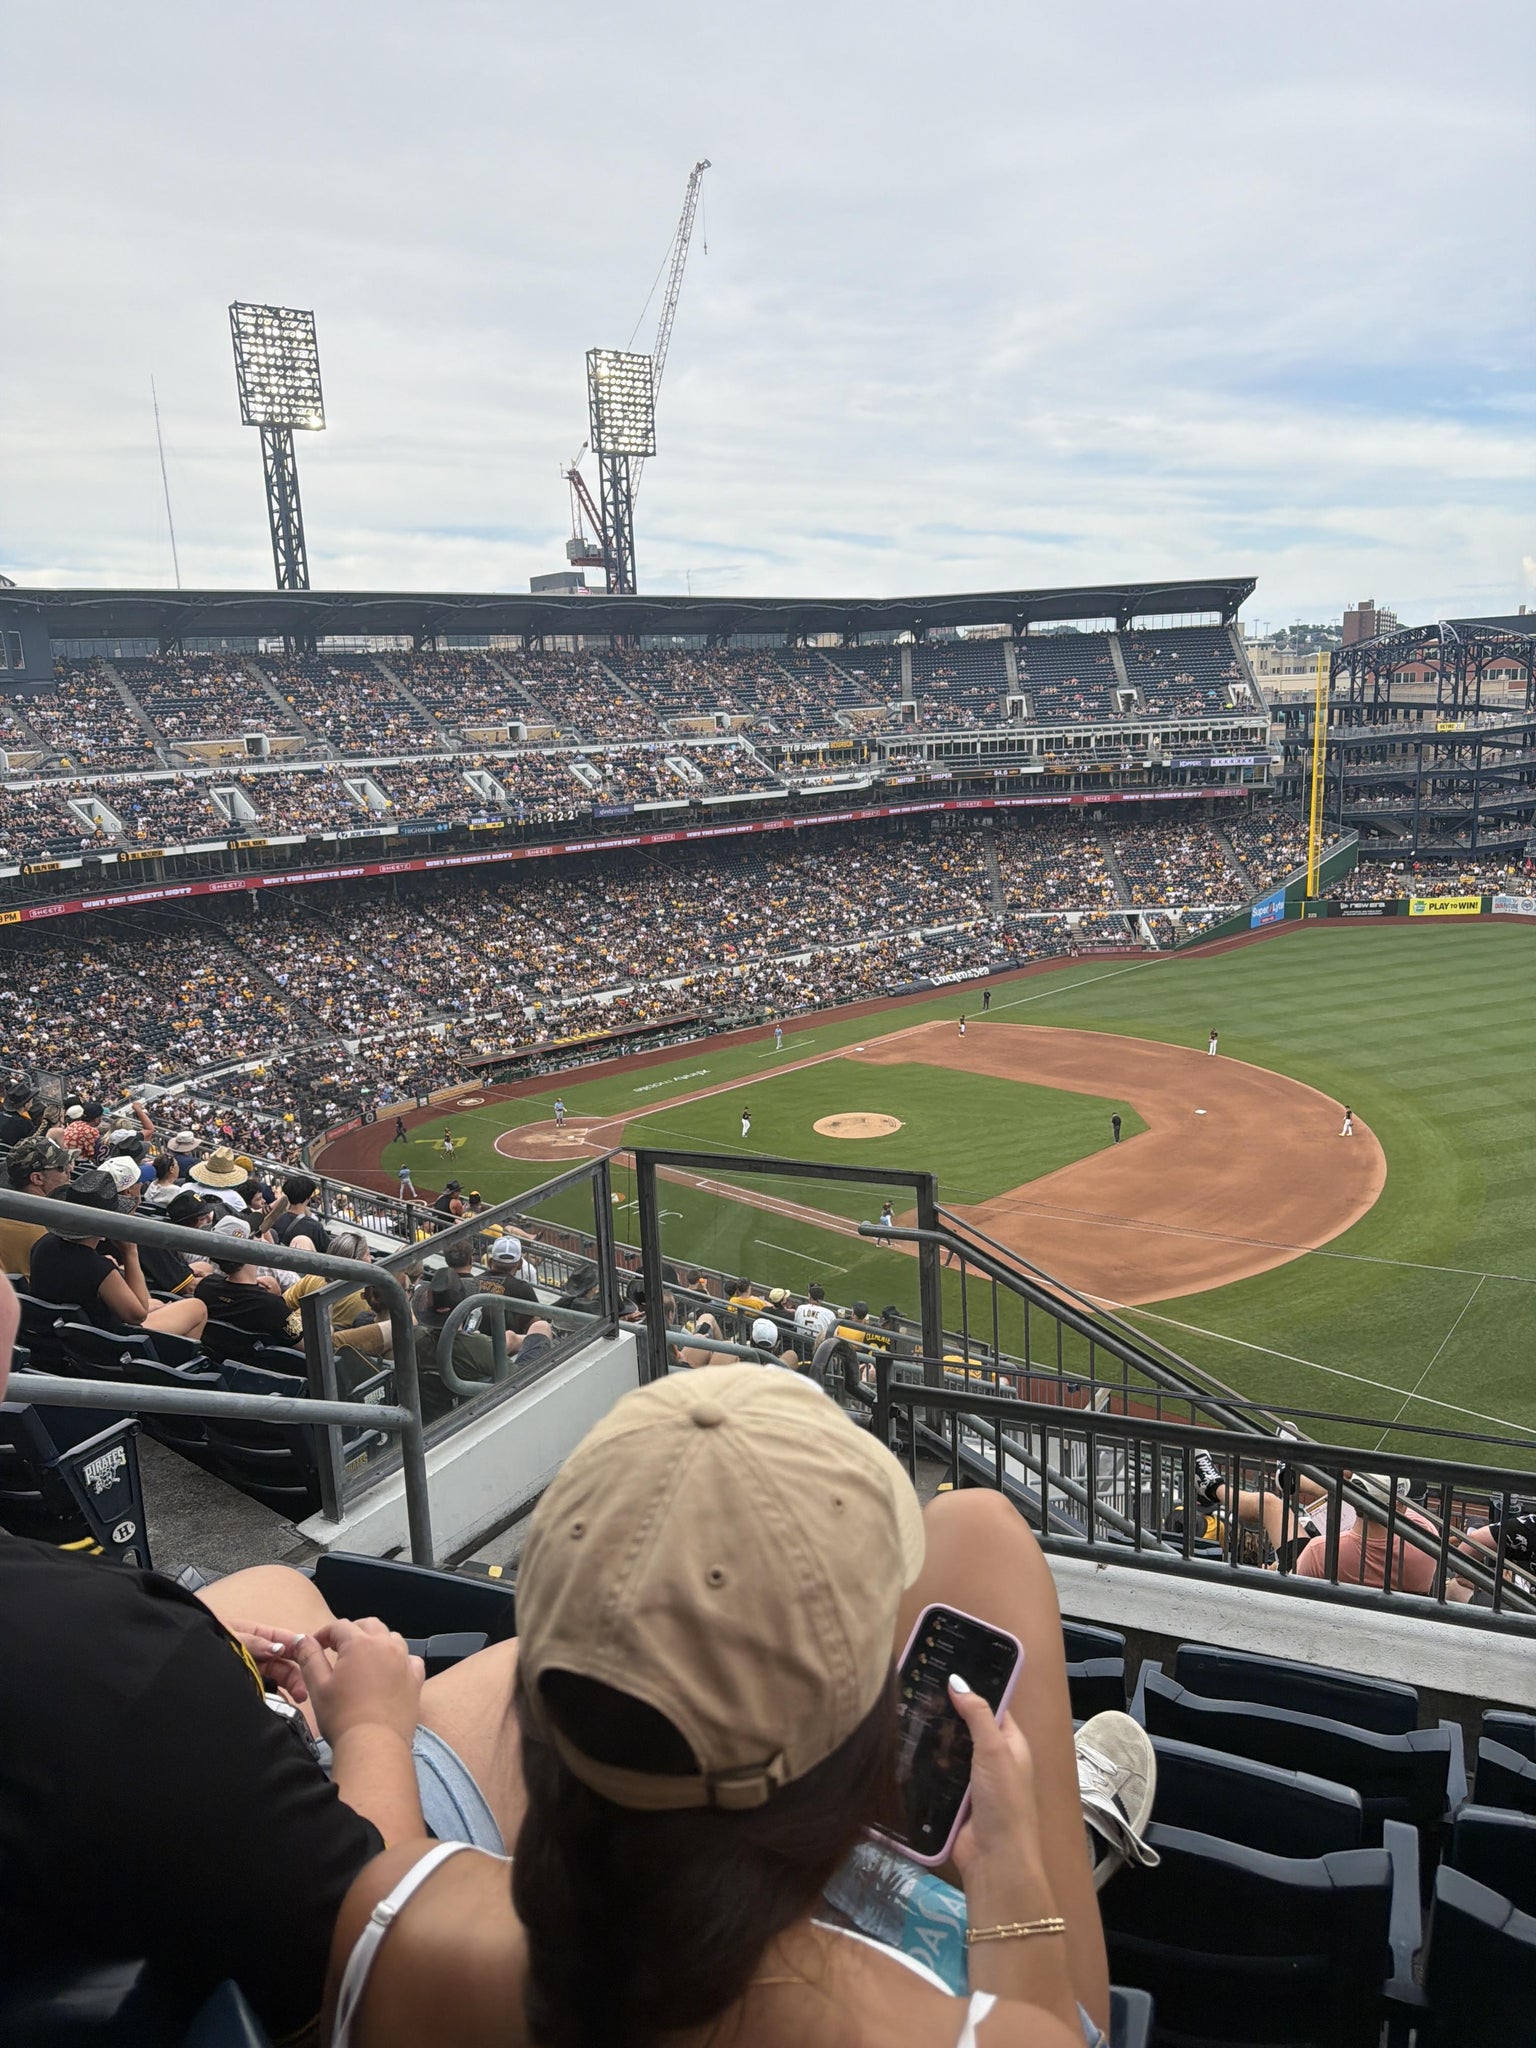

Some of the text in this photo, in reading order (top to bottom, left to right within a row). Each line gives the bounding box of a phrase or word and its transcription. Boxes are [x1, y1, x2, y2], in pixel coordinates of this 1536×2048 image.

[781, 745, 794, 753] CITY
[794, 744, 801, 752] OF
[801, 742, 830, 751] CHAMPIONS
[547, 812, 554, 822] 2
[557, 811, 564, 821] 2
[567, 810, 575, 821] 2
[337, 831, 348, 840] 42
[406, 826, 436, 835] HIGHMARK
[229, 840, 237, 849] 11
[119, 853, 127, 862] 9
[23, 866, 30, 875] 4
[1252, 905, 1269, 918] Super
[1429, 902, 1450, 911] PLAY
[1458, 902, 1478, 910] WIN!
[4, 912, 17, 922] PM
[930, 971, 968, 986] Chicken
[971, 966, 990, 978] Sea
[193, 1193, 202, 1202] P
[803, 1309, 820, 1319] LOWE
[82, 1445, 127, 1485] PIRATES
[118, 1524, 131, 1540] H
